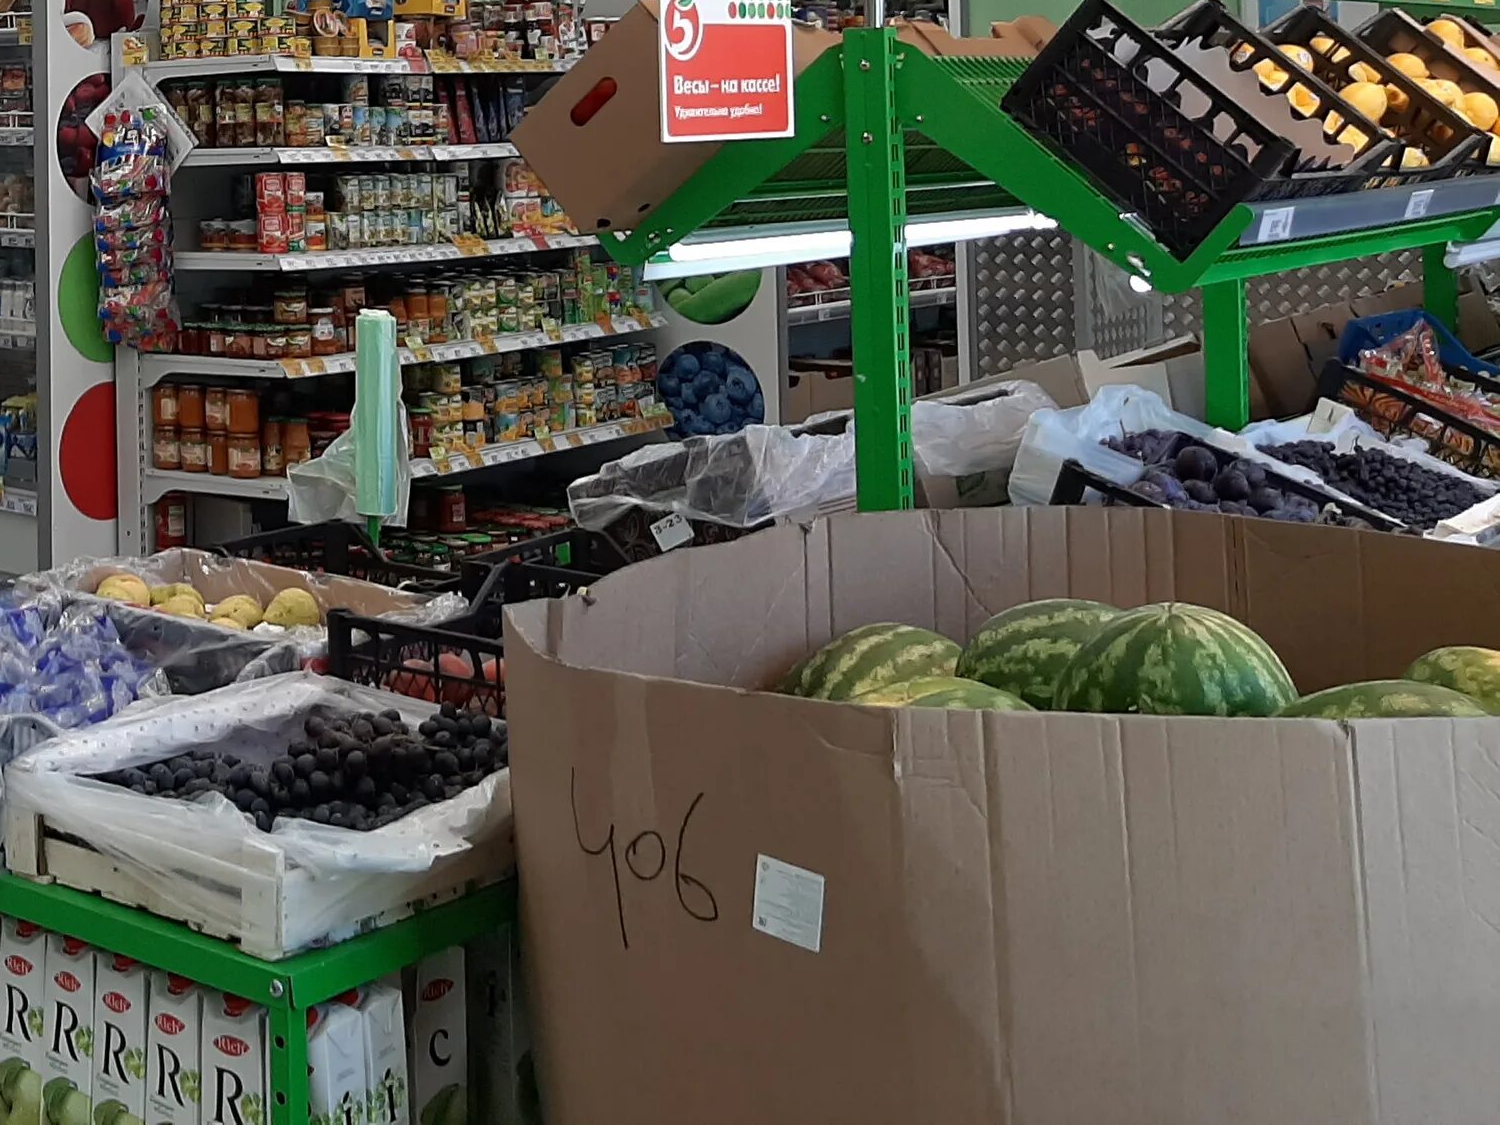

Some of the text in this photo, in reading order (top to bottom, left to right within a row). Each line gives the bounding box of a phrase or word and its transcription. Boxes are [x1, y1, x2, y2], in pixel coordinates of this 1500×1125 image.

[674, 74, 779, 94] Весы на кассе!
[5, 983, 32, 1043] R
[52, 1000, 79, 1062] R
[103, 1021, 130, 1085] R
[158, 1043, 184, 1108] R
[214, 1065, 244, 1125] R
